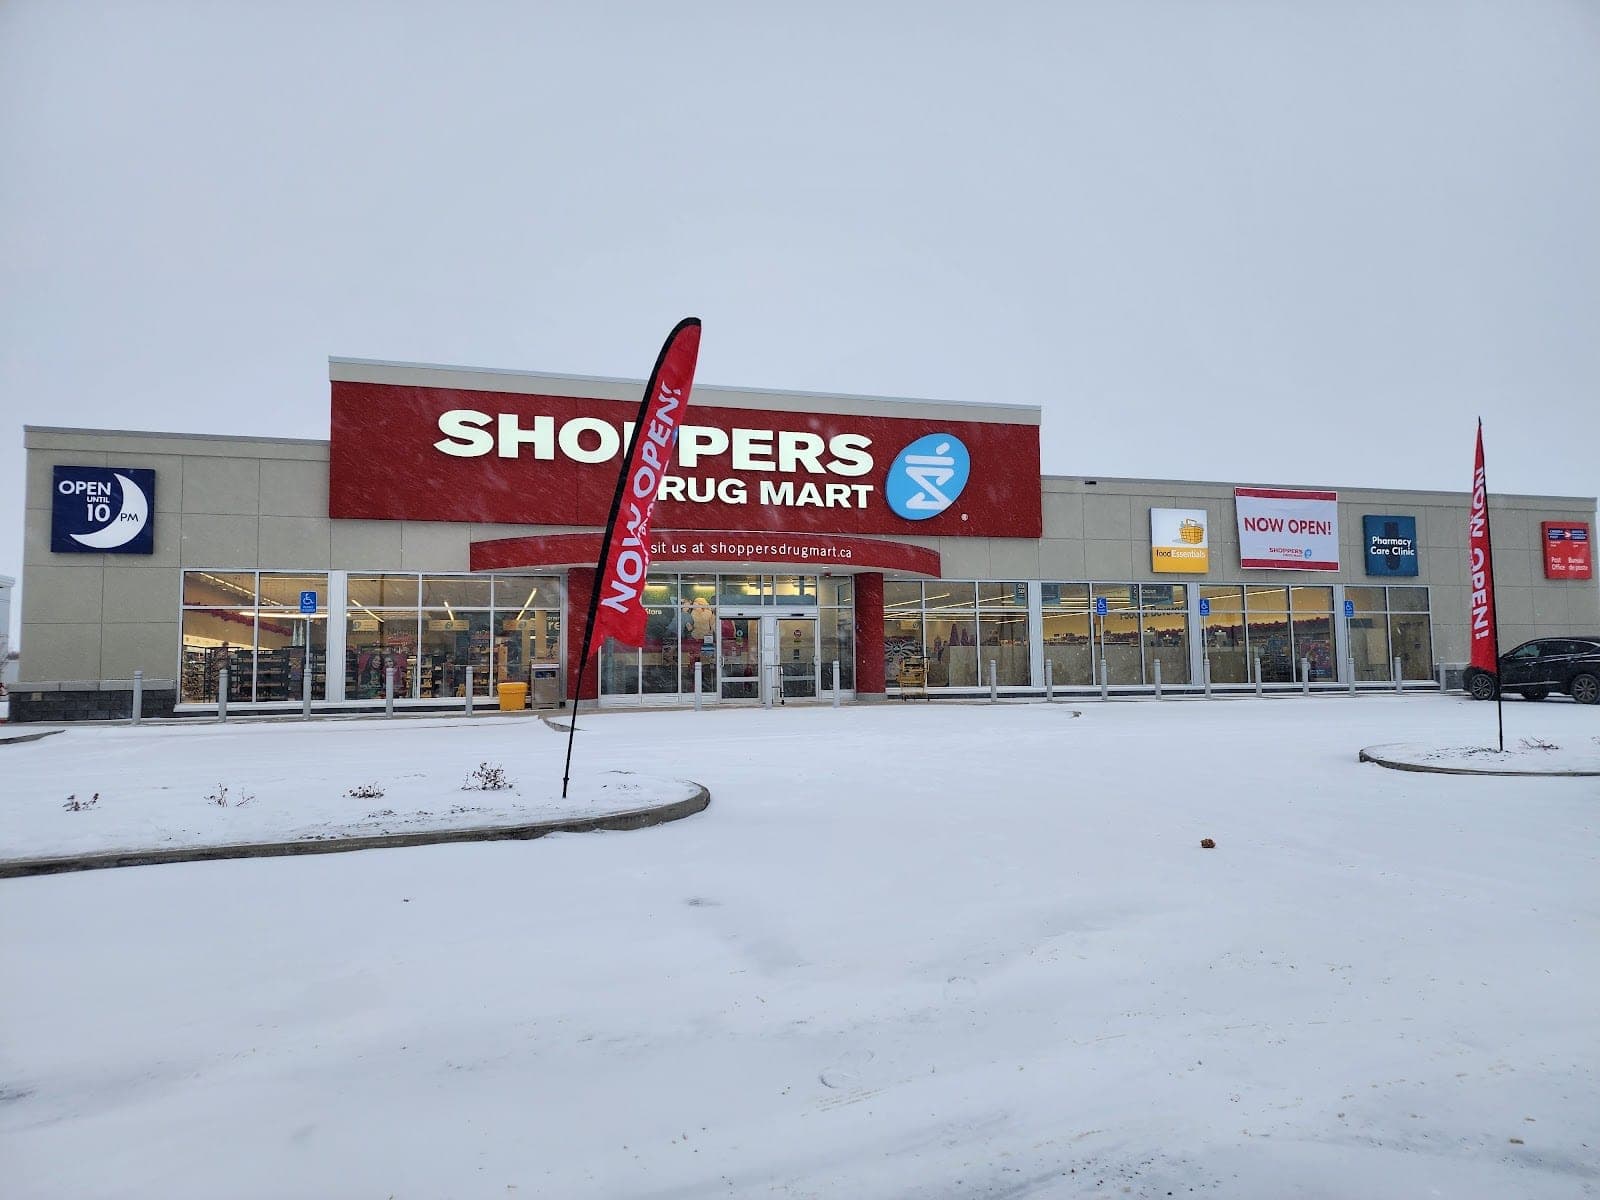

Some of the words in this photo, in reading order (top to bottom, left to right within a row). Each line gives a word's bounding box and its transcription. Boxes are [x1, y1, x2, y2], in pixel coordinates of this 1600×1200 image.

[433, 409, 874, 476] SHOPERS
[59, 480, 111, 495] OPEN
[656, 476, 747, 504] RUG
[760, 480, 874, 508] MART
[87, 504, 110, 522] 10
[120, 513, 139, 522] PM
[1244, 517, 1284, 533] NOW
[1288, 519, 1332, 536] OPEN!
[671, 542, 687, 554] us
[691, 541, 705, 554] at
[711, 541, 852, 558] shoppersdrugmart.ca
[1372, 536, 1412, 548] Pharmacy
[1371, 546, 1390, 555] Care
[1392, 547, 1415, 556] Clinic
